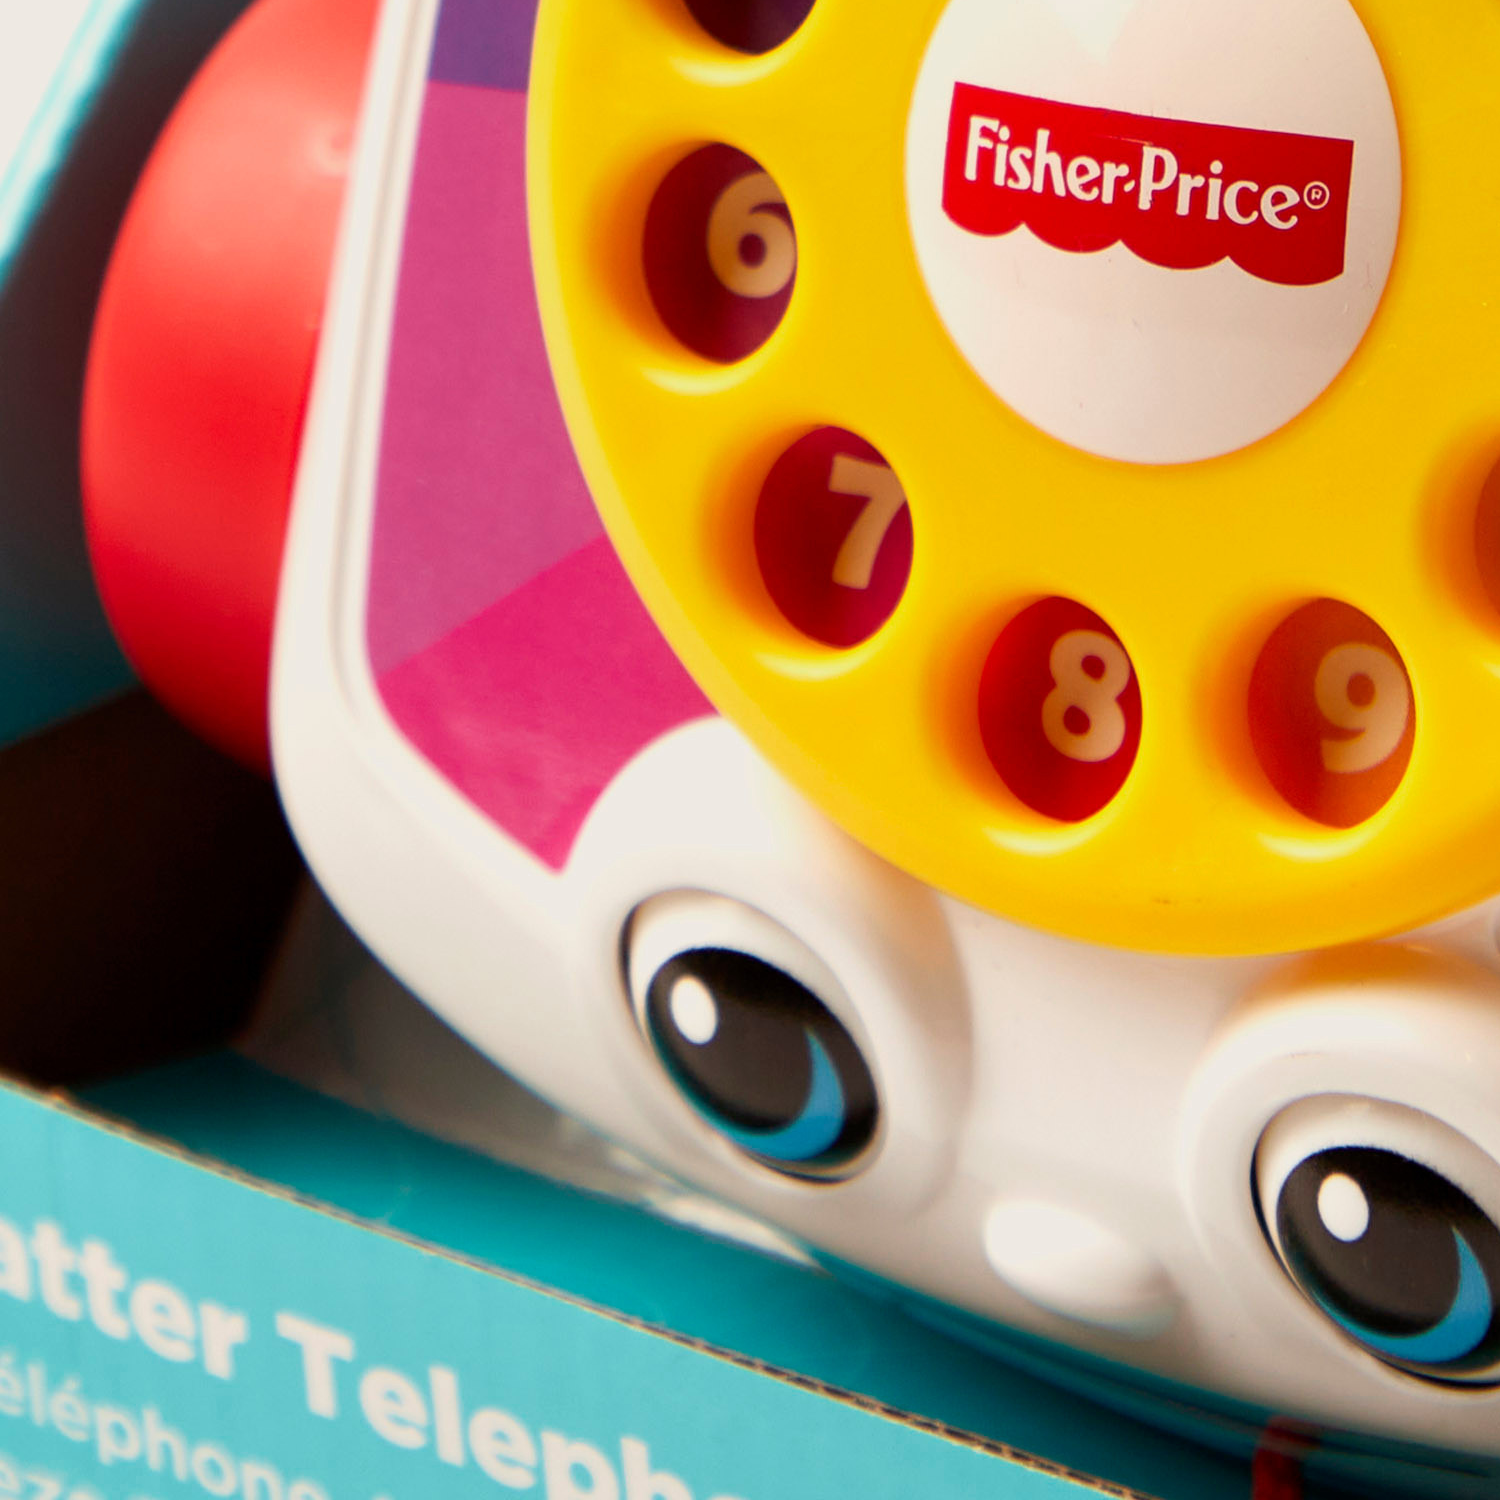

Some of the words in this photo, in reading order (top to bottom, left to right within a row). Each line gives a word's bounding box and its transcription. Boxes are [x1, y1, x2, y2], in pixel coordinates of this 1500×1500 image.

[707, 171, 797, 299] 6
[828, 452, 907, 591] 7
[1041, 629, 1131, 762] 8
[1314, 642, 1410, 775] 9
[274, 1310, 745, 1500] Teleph
